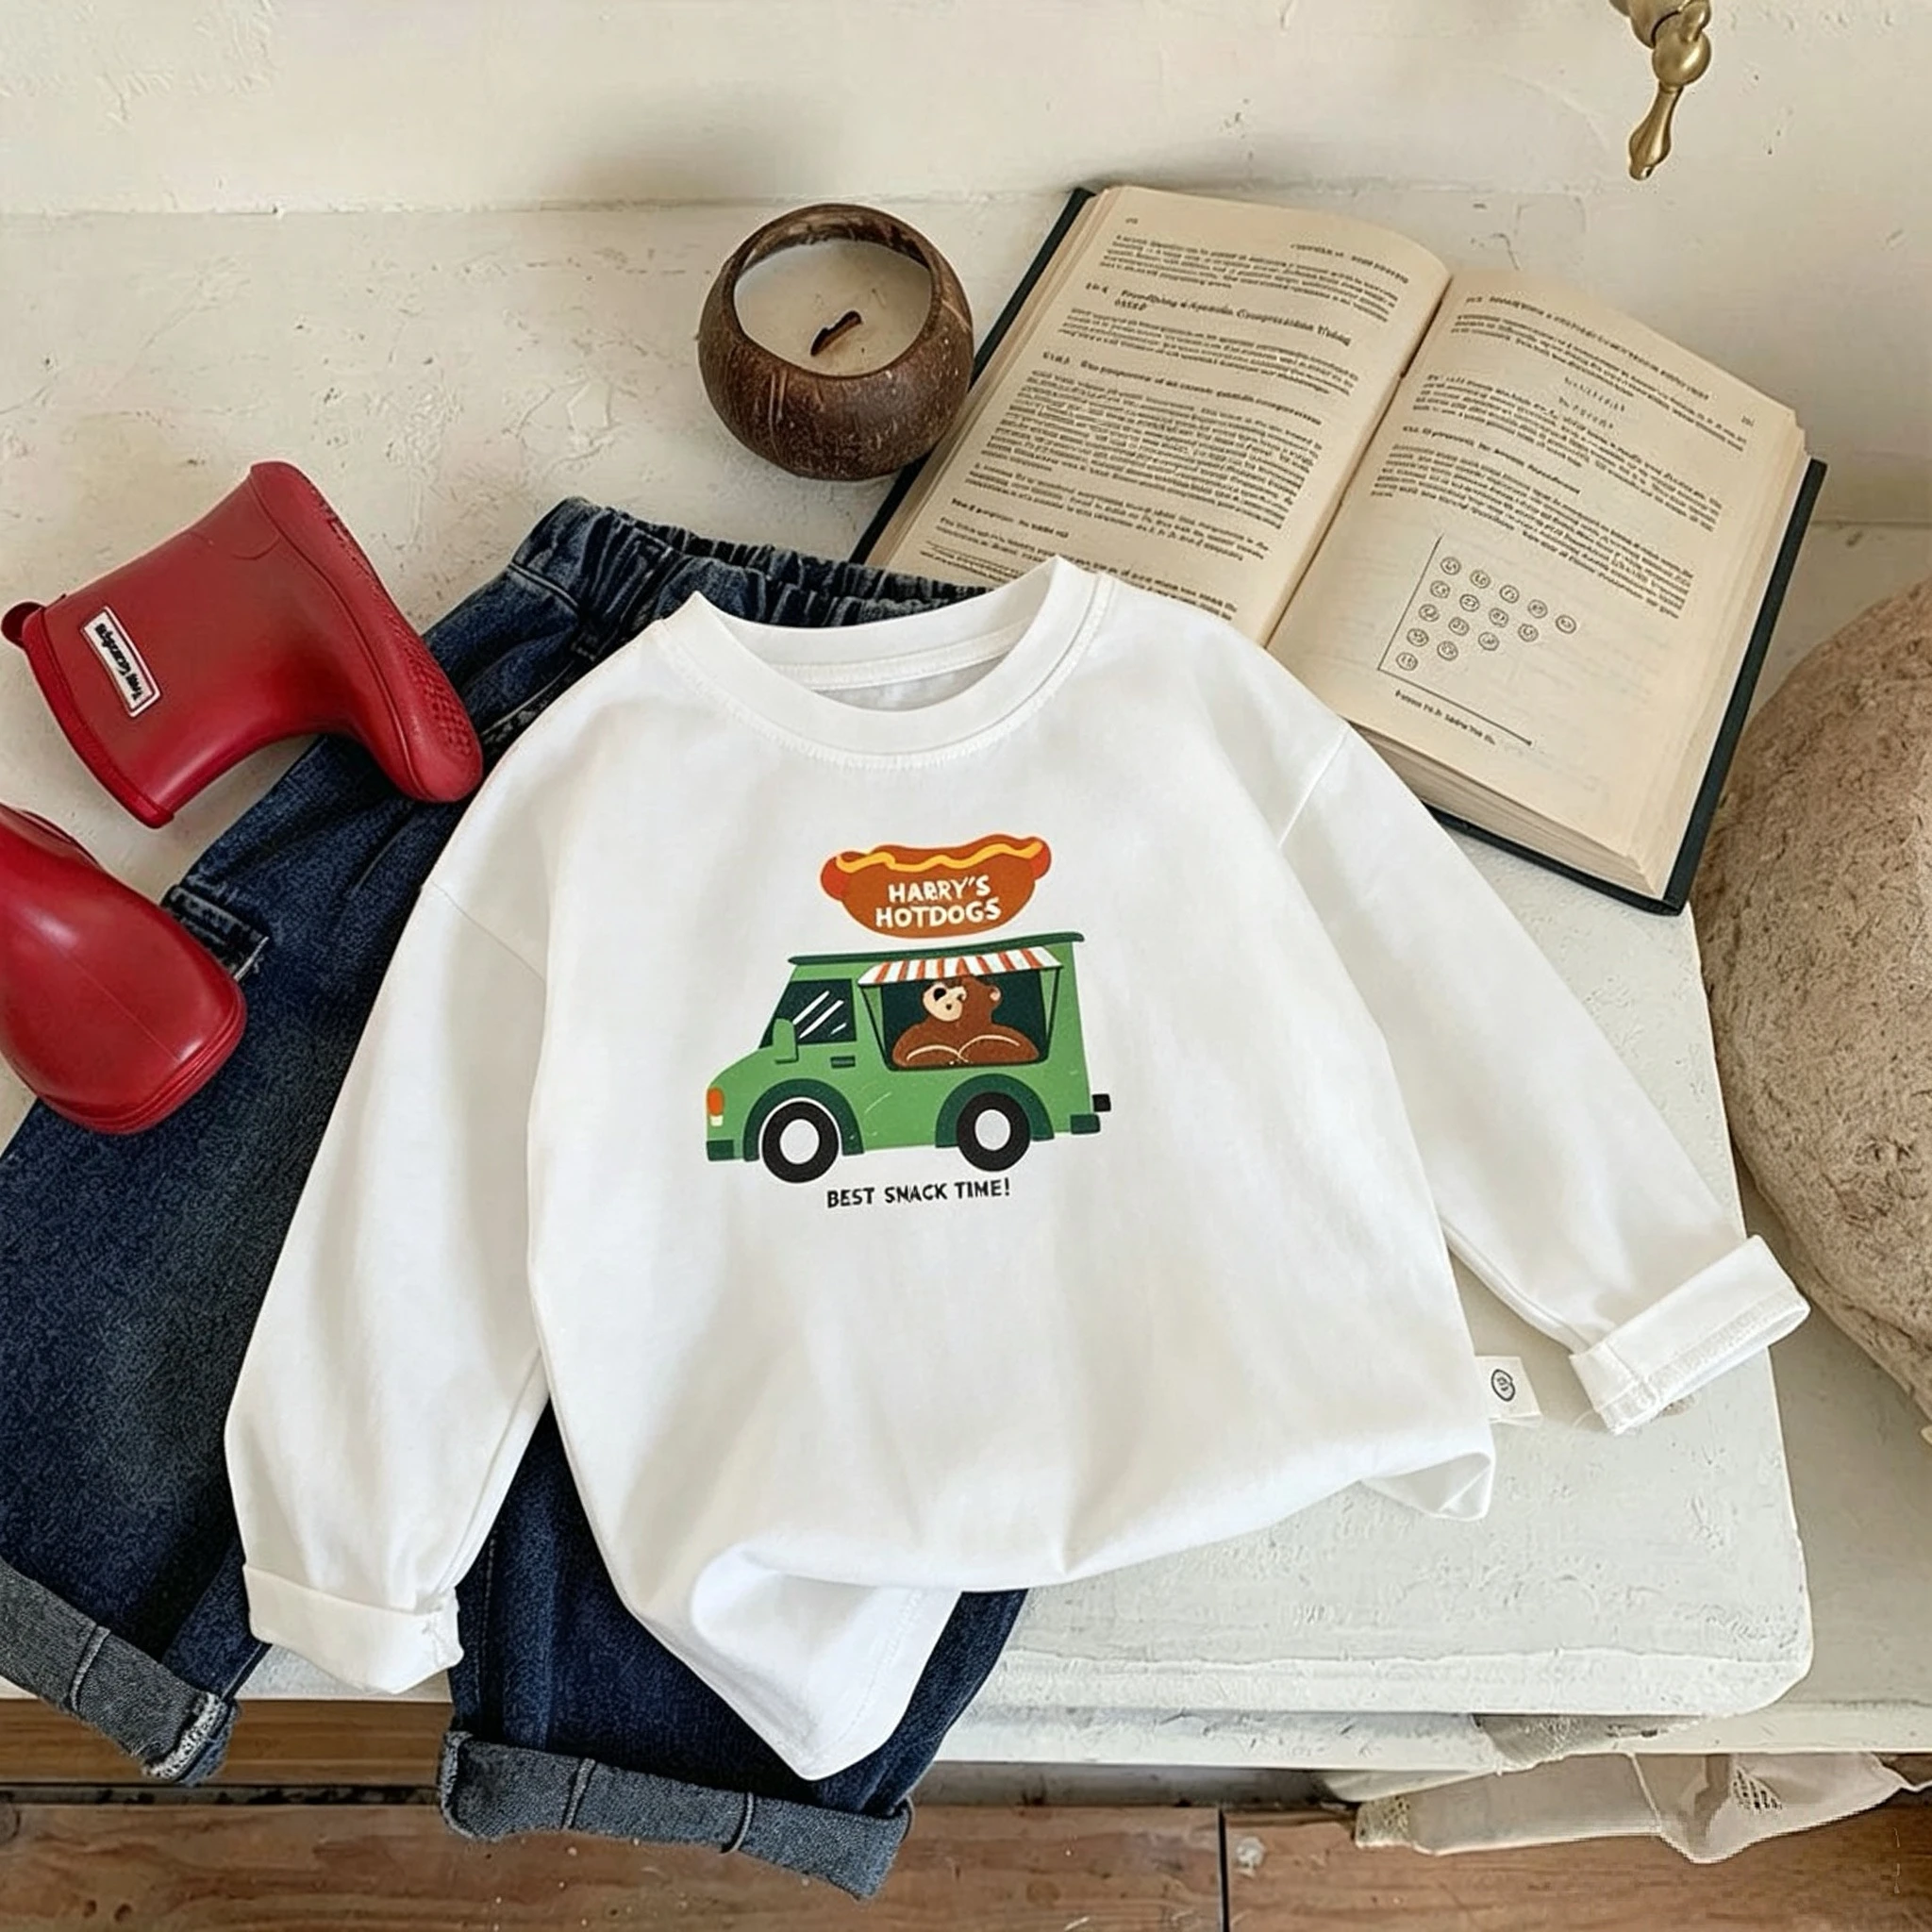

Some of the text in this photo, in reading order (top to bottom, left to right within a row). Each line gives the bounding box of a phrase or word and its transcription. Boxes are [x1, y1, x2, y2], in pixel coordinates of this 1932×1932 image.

[875, 897, 1001, 928] HOTDOGS
[827, 1176, 1010, 1208] BEST SNACK TIME!
